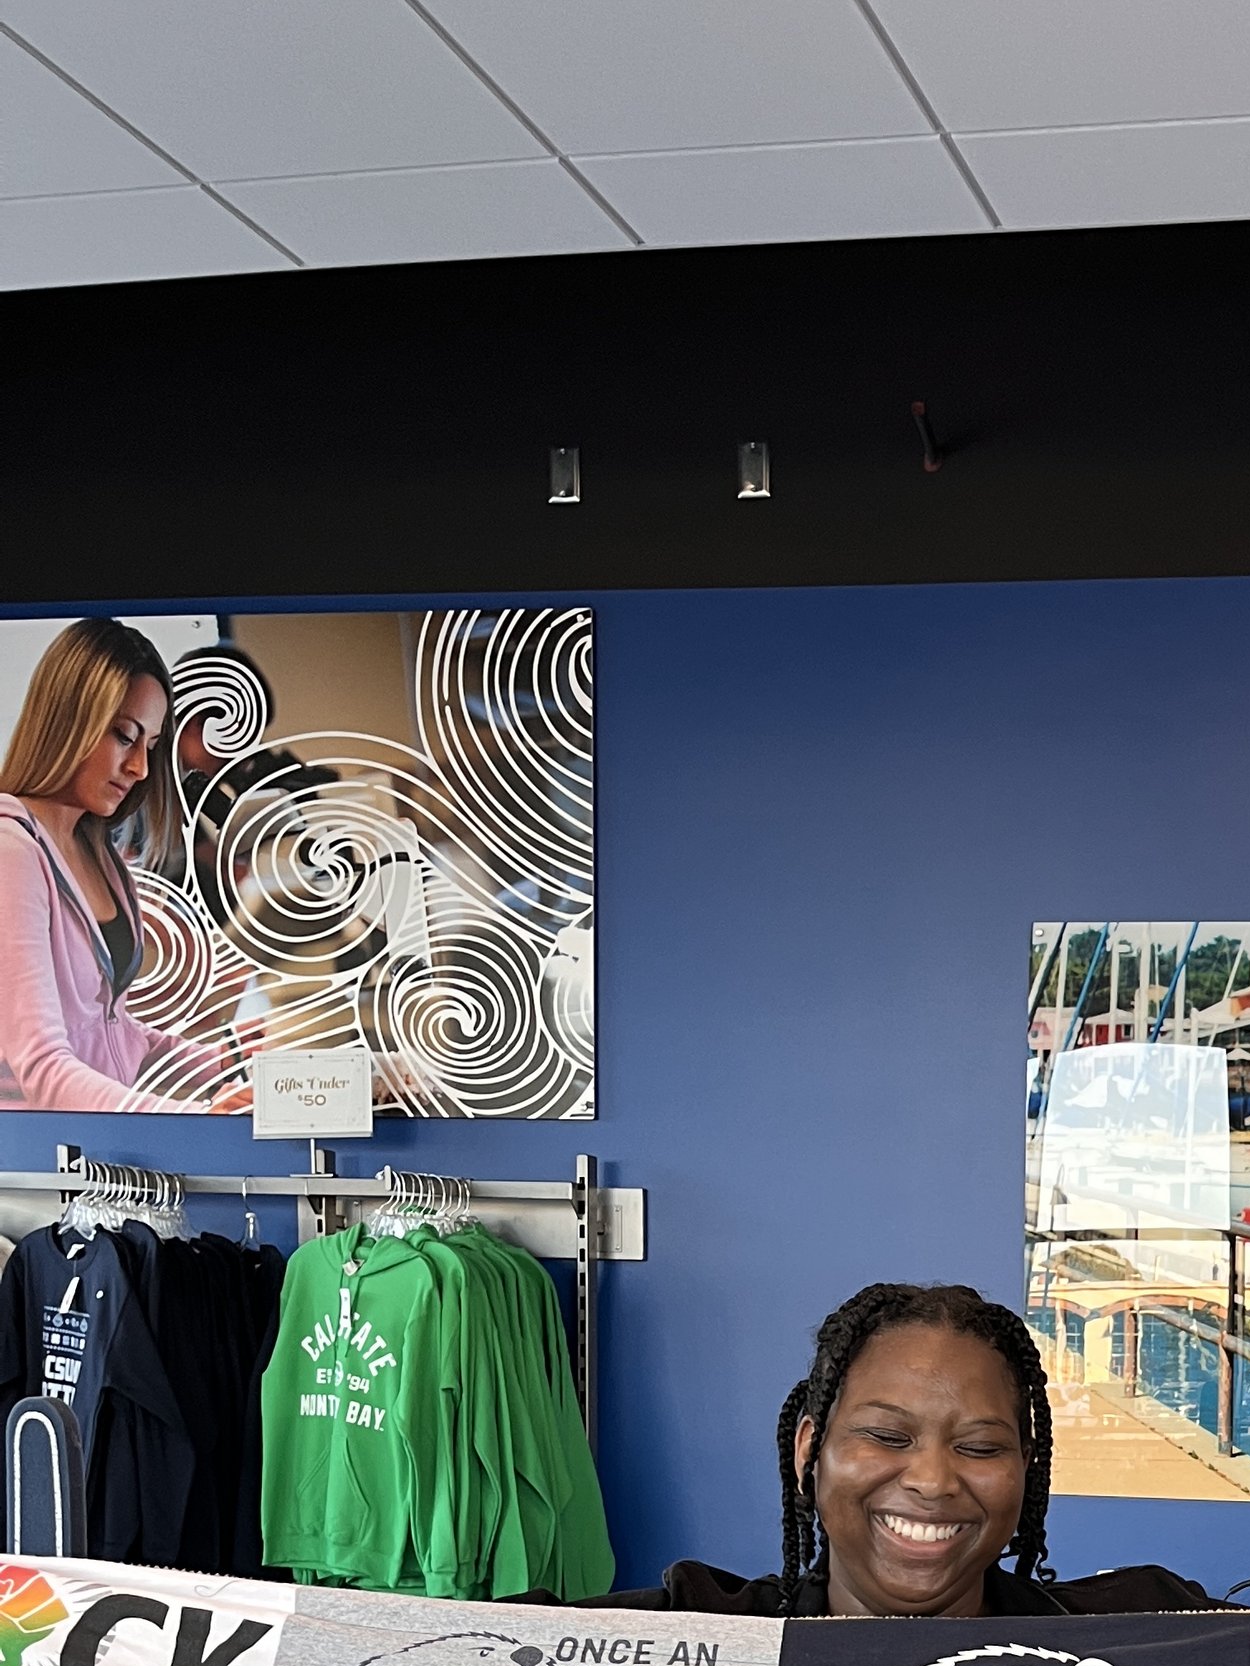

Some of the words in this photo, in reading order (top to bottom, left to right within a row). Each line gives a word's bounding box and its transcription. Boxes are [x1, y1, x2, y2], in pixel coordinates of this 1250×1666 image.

[274, 1077, 303, 1094] Gifts
[306, 1076, 350, 1090] Under
[297, 1094, 327, 1106] $50
[556, 1637, 655, 1666] ONCE
